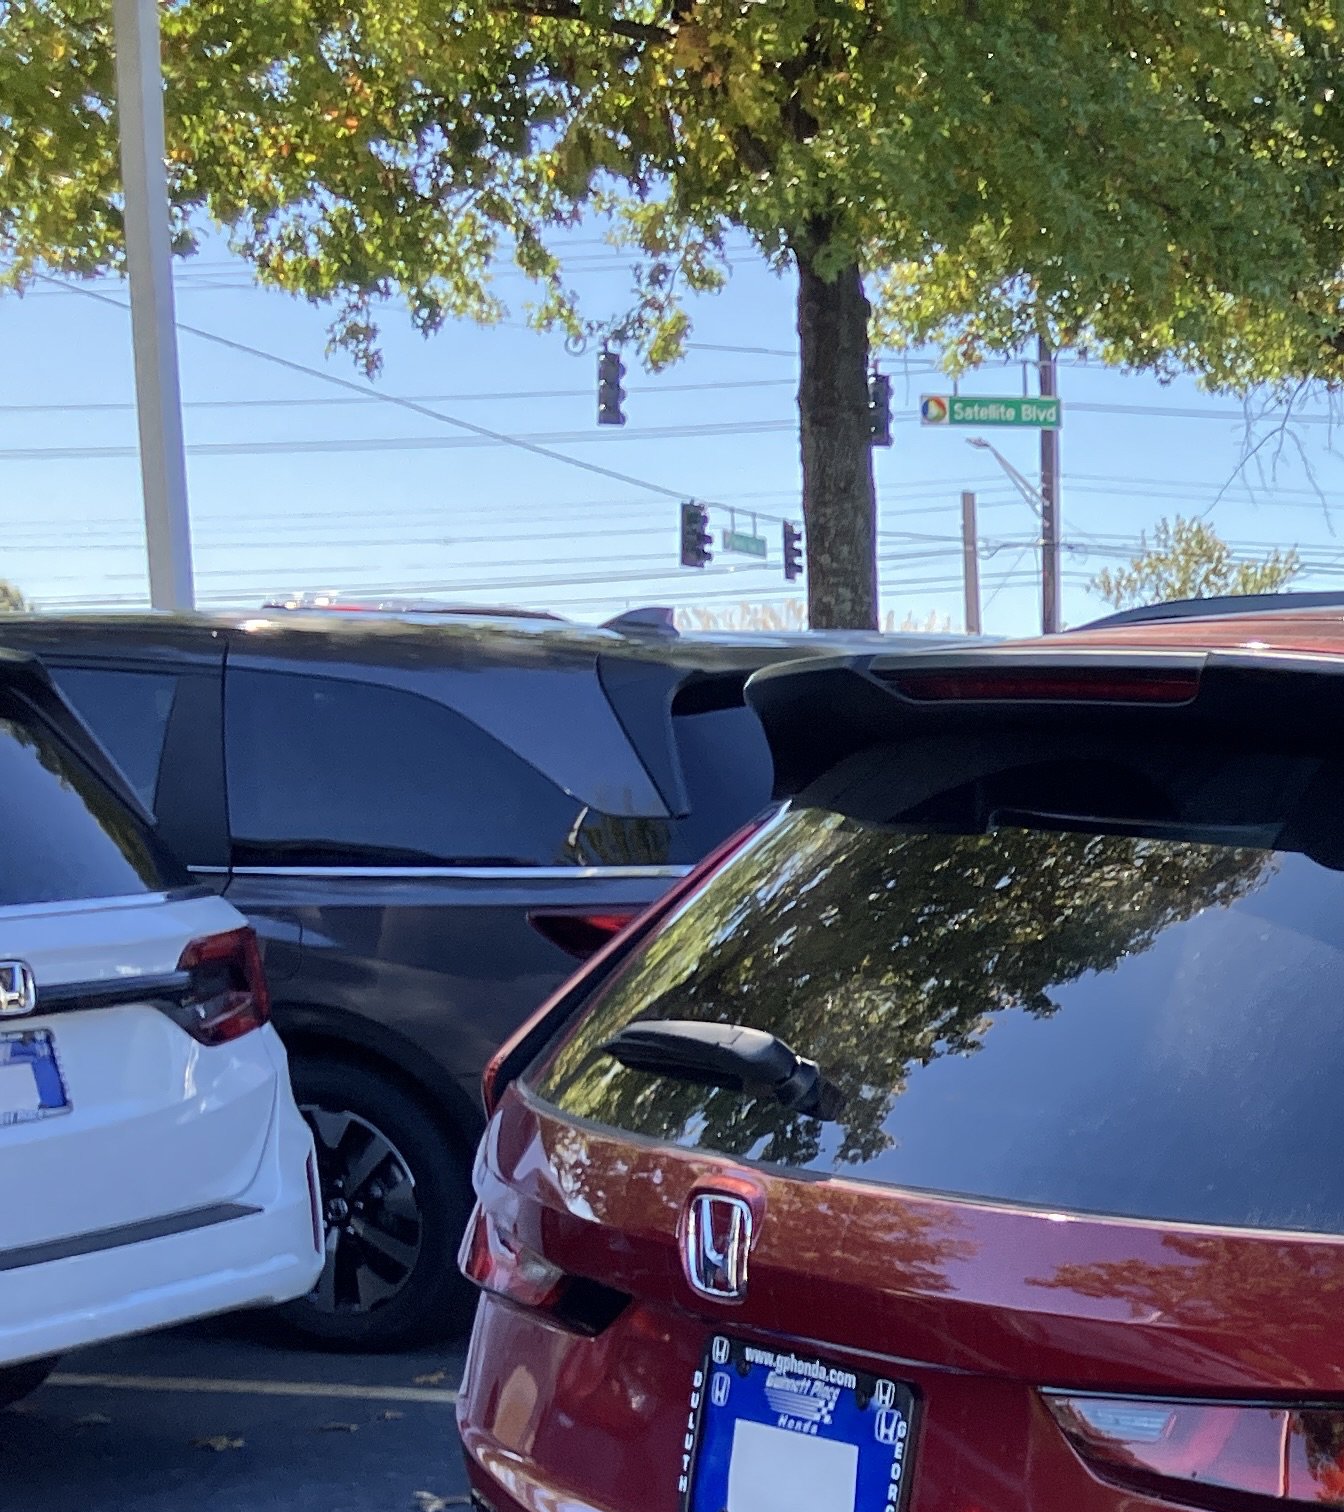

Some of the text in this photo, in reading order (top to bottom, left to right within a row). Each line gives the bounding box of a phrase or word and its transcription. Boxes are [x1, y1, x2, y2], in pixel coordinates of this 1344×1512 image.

[953, 402, 1057, 423] Satellite Blvd
[745, 1347, 857, 1390] www.gphonda.com
[678, 1369, 702, 1493] DULUTH
[777, 1414, 819, 1435] Honda
